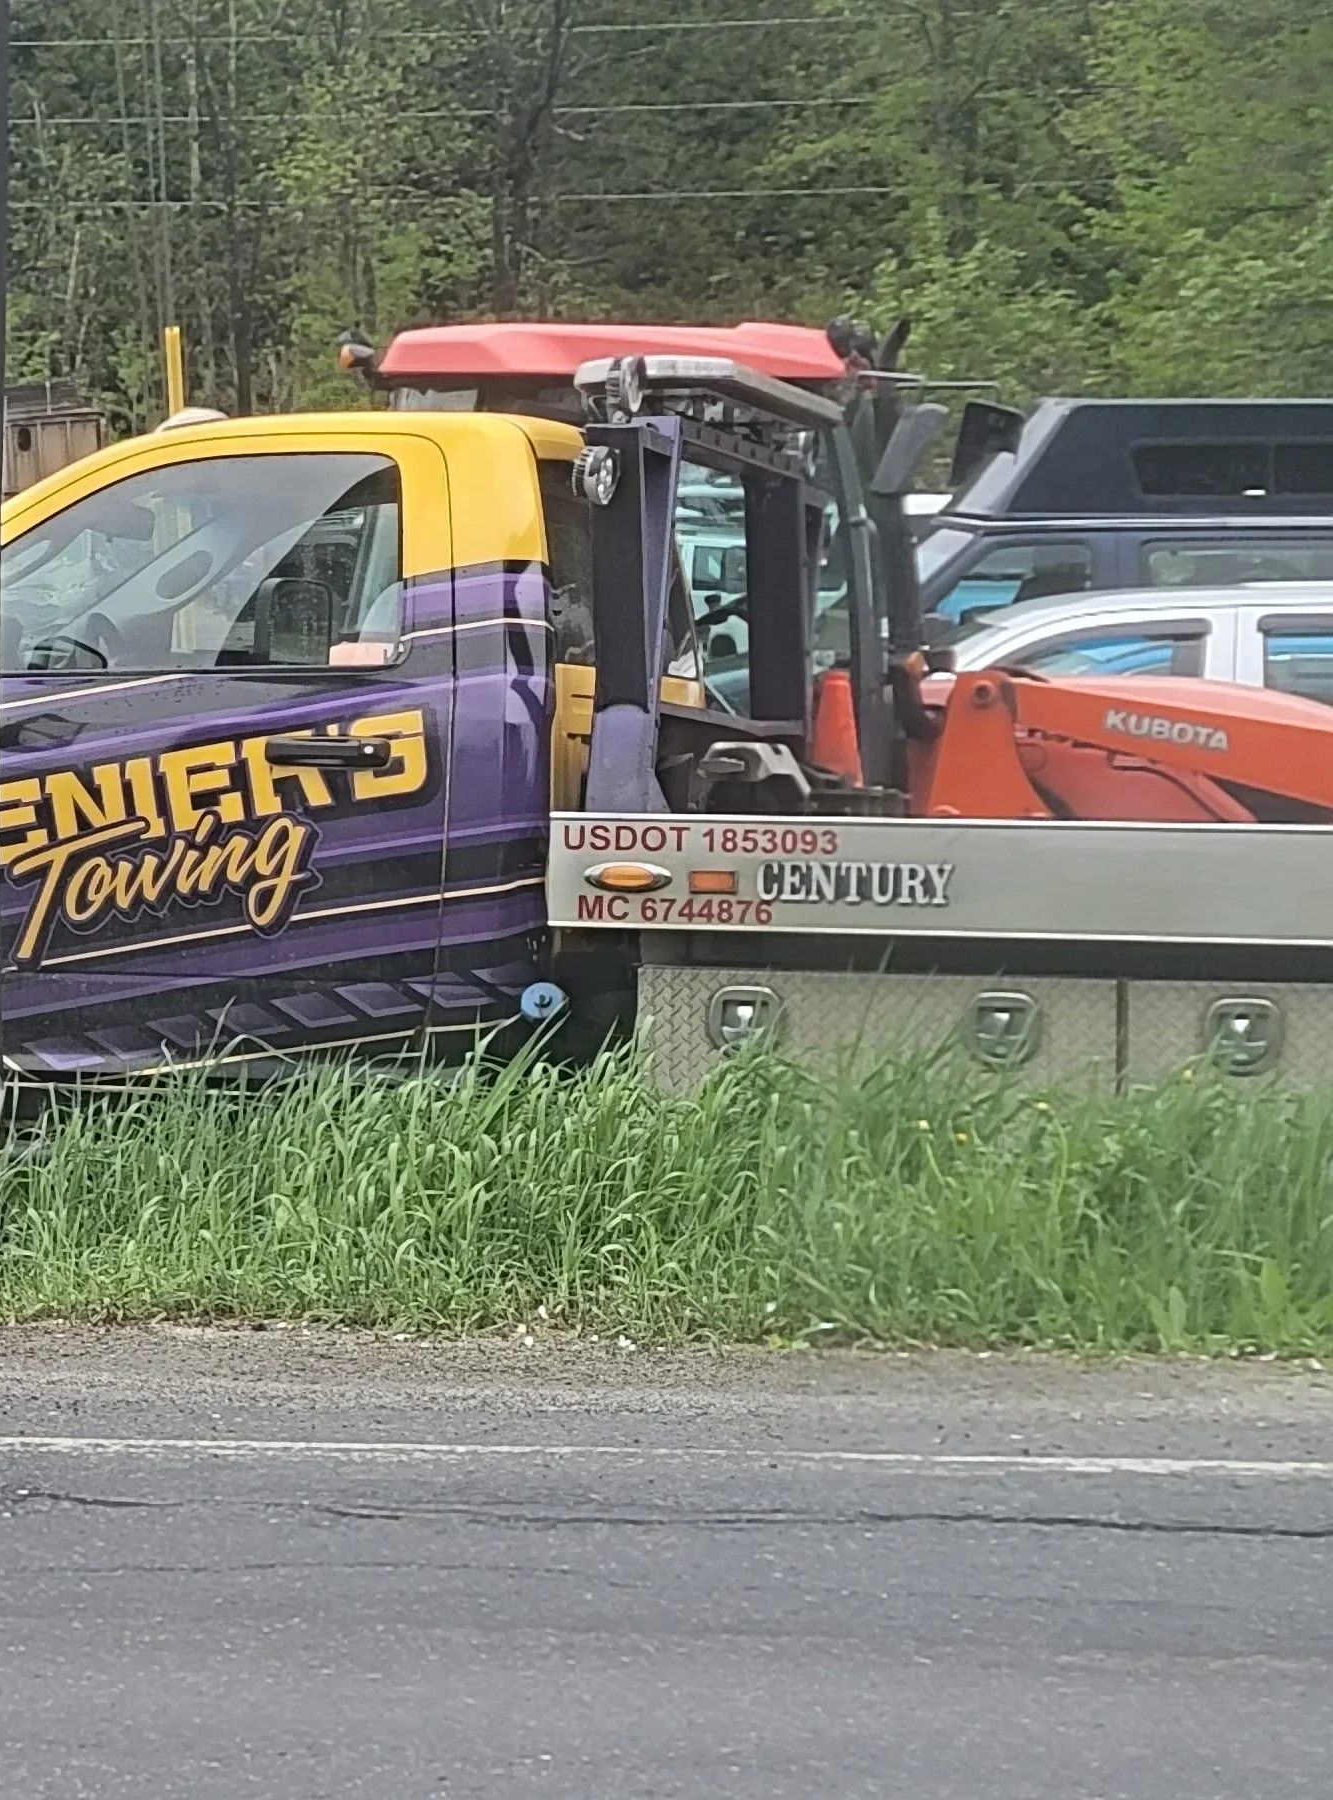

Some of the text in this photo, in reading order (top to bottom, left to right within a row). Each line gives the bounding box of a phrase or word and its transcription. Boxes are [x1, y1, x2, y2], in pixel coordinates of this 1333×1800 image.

[1104, 708, 1230, 751] KUBOTA
[564, 824, 839, 855] USDOT 1853093
[13, 814, 310, 959] Towing
[755, 859, 954, 906] CENTURY
[577, 894, 774, 925] MC 6744876
